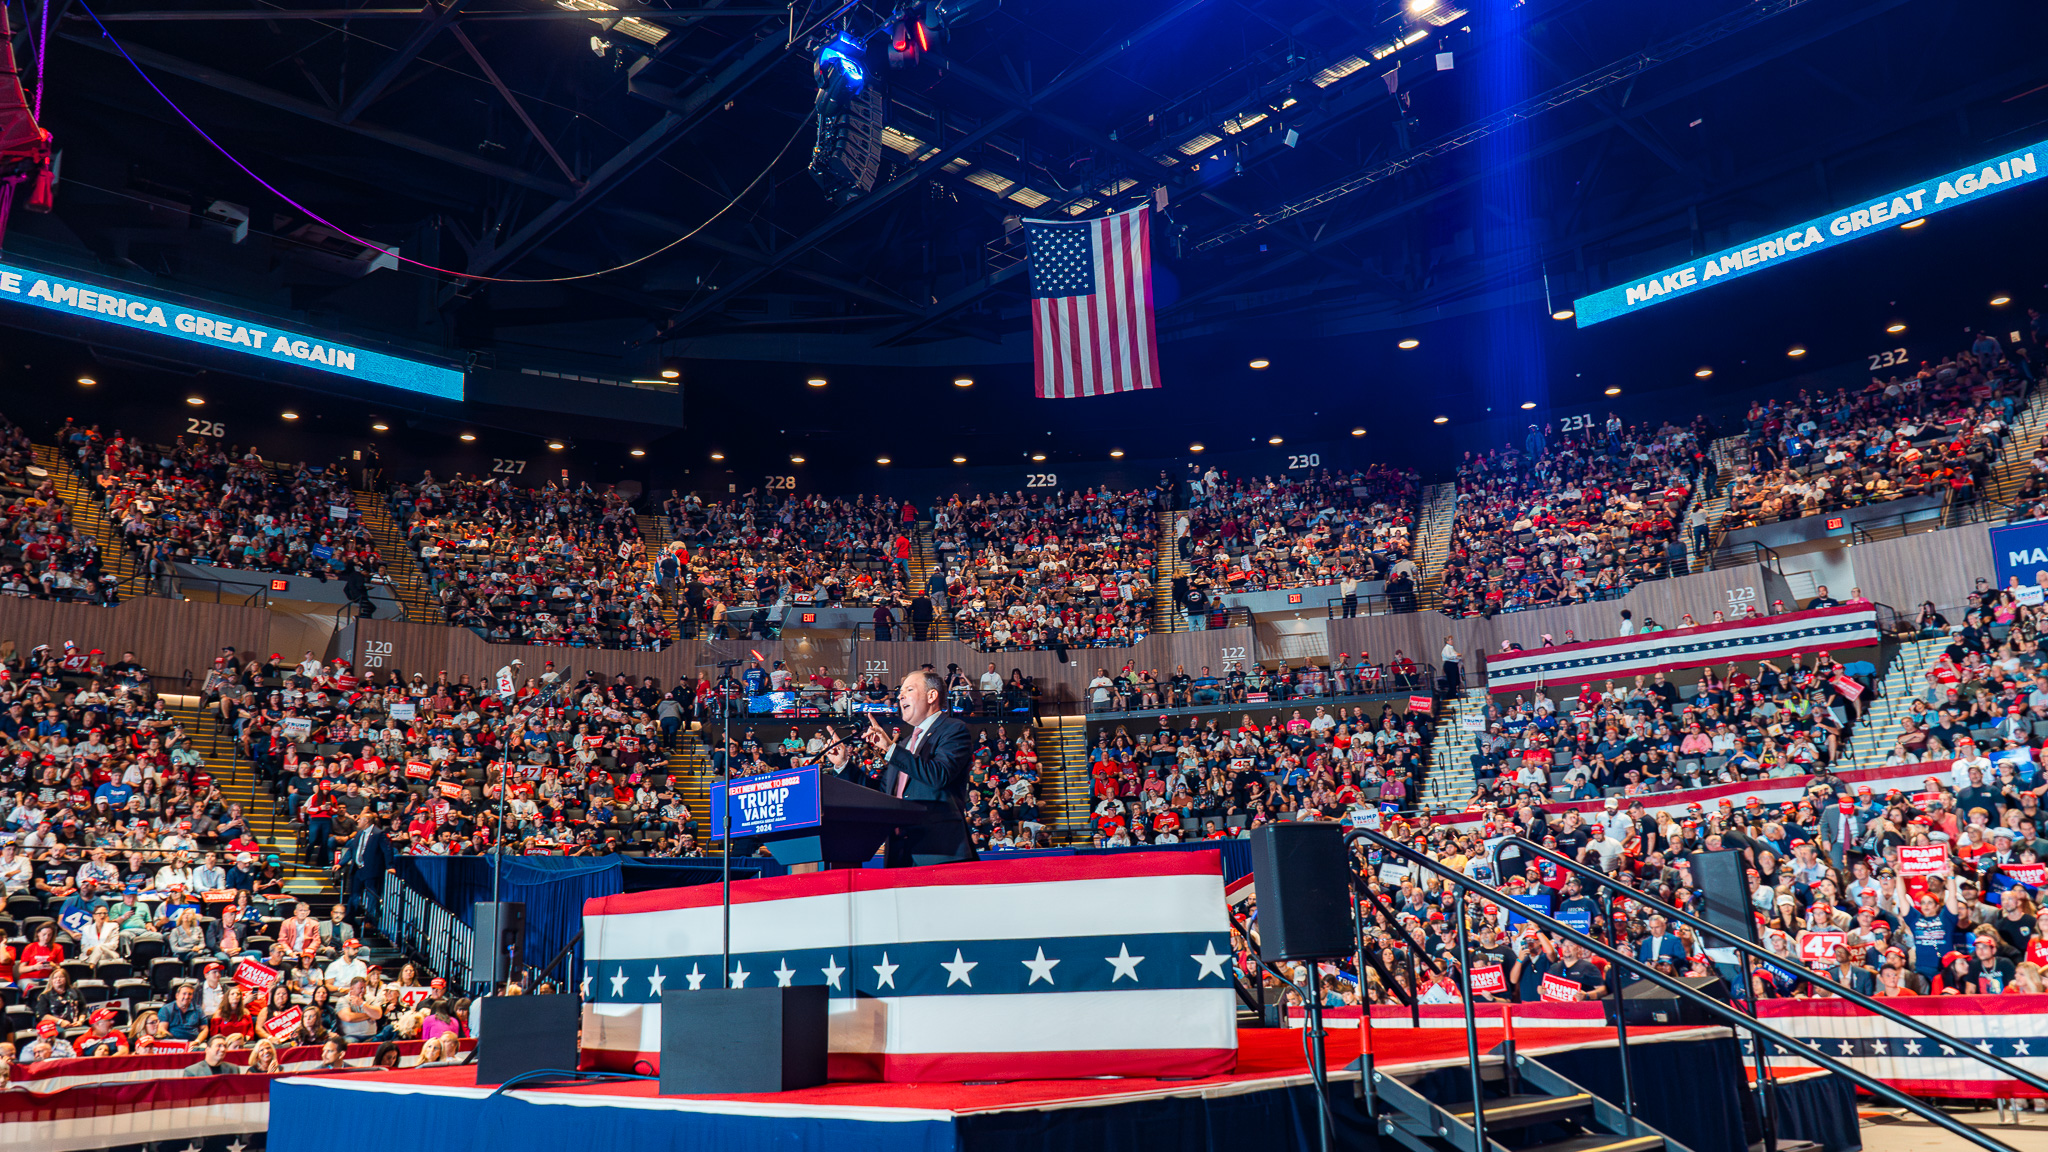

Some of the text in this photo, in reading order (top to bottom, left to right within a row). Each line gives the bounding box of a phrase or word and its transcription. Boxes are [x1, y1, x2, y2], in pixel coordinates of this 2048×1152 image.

[1625, 152, 2037, 306] MAKE AMERICA GREAT AGAIN
[0, 271, 356, 371] E AMERICA GREAT AGAIN
[1868, 348, 1909, 371] 232
[186, 418, 225, 438] 226
[1560, 413, 1595, 433] 231
[493, 458, 527, 474] 227
[1288, 453, 1320, 470] 230
[765, 475, 796, 490] 228
[1026, 473, 1057, 488] 229
[1827, 518, 1842, 530] EXIT
[620, 544, 629, 557] 47
[2009, 547, 2048, 567] MA
[272, 580, 286, 591] EXIT
[1726, 586, 1755, 601] 123
[1730, 603, 1747, 617] 23
[803, 613, 815, 622] EXIT
[366, 640, 392, 654] 120
[1222, 647, 1246, 659] 122
[67, 656, 89, 668] 47
[364, 656, 383, 668] 20
[866, 660, 888, 671] 121
[1361, 668, 1378, 678] 47
[501, 678, 512, 693] 47
[521, 768, 539, 778] 47
[743, 785, 755, 793] NEW
[756, 782, 772, 791] YORK
[773, 780, 781, 788] TO
[738, 788, 789, 809] TRUMP
[744, 804, 784, 821] VANCE
[1353, 813, 1377, 822] TRUMP
[756, 824, 772, 833] 2024
[1903, 848, 1942, 858] DRAIN
[1903, 861, 1943, 870] SWAMP
[2014, 875, 2041, 883] ANCE
[65, 912, 93, 929] 47
[1804, 936, 1842, 957] 47
[240, 963, 274, 982] TRUMP
[1472, 971, 1501, 980] RUMP
[1763, 961, 1794, 985] TRUMP
[1544, 981, 1578, 995] TRUMP
[1546, 989, 1573, 1001] VANCE
[402, 991, 428, 1006] 47
[268, 1009, 300, 1031] DRAIN
